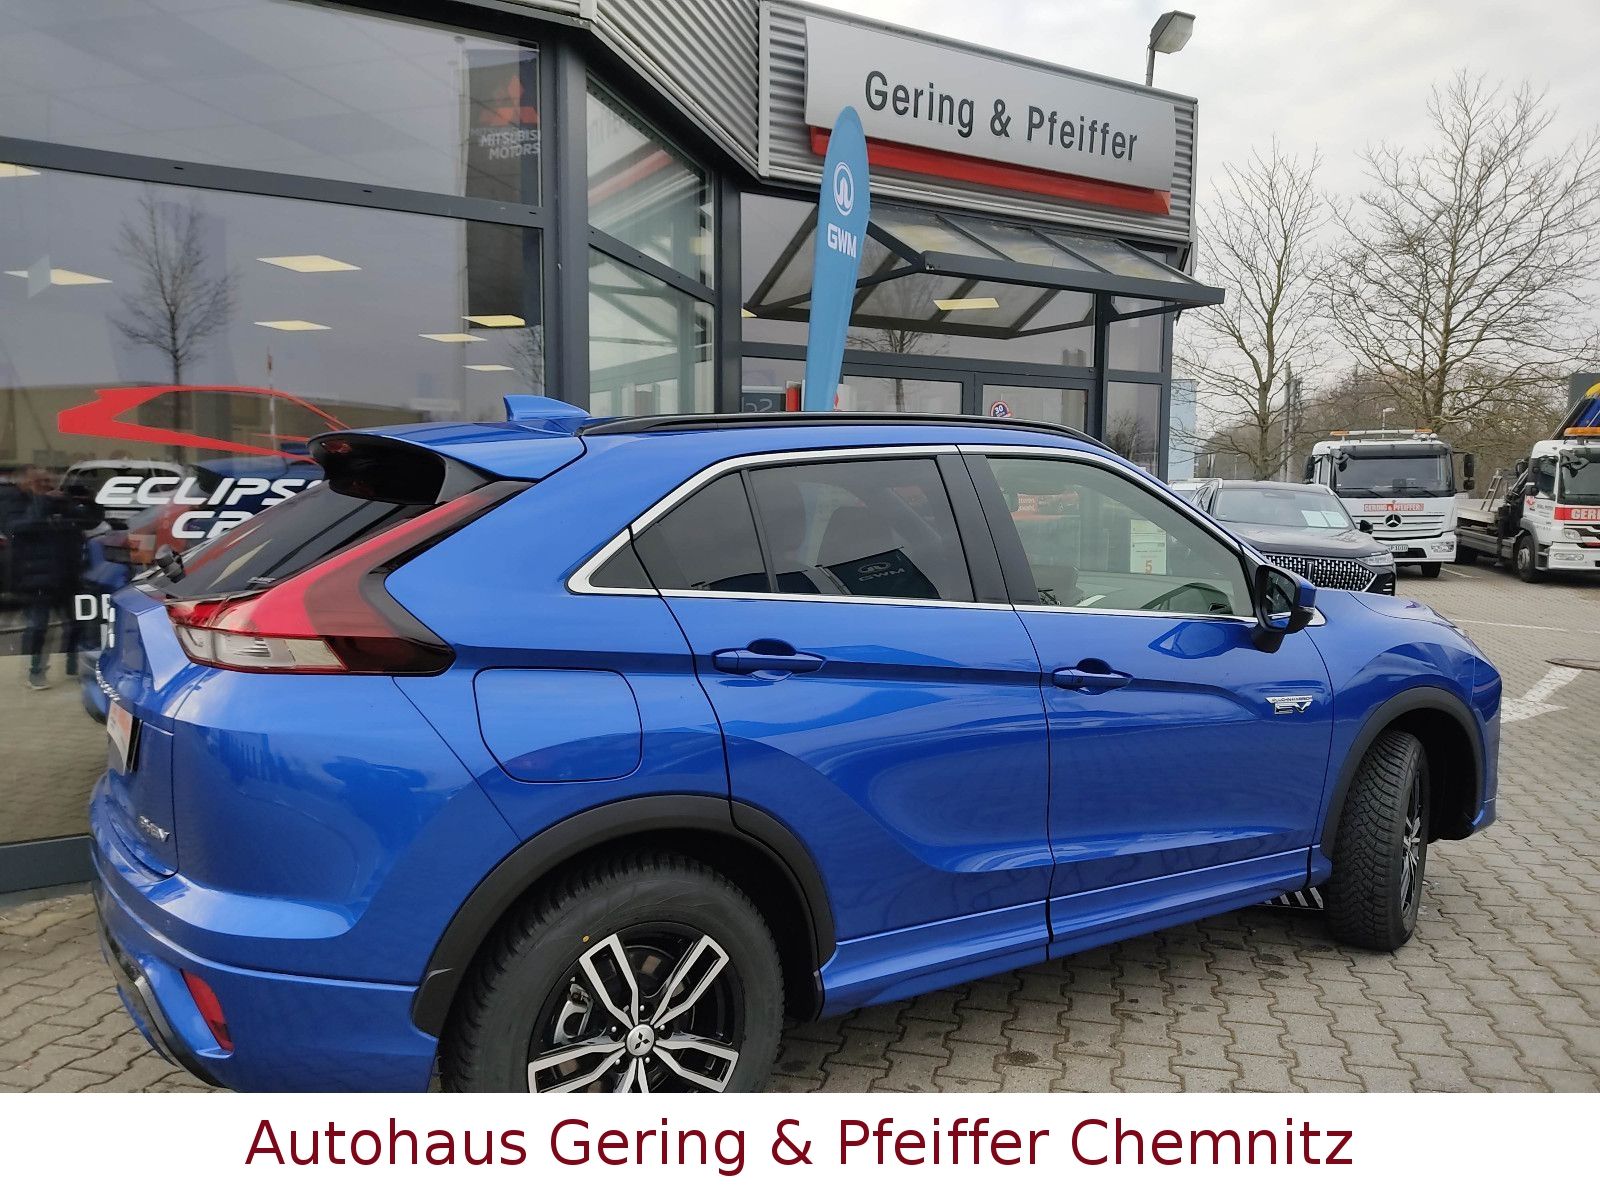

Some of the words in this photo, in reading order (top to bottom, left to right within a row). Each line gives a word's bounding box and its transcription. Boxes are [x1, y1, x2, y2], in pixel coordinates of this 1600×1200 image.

[865, 70, 974, 138] Gering
[990, 98, 1012, 138] &
[1027, 105, 1138, 161] Pfeiffer
[827, 222, 857, 258] GWM
[95, 476, 322, 505] ECLIPS
